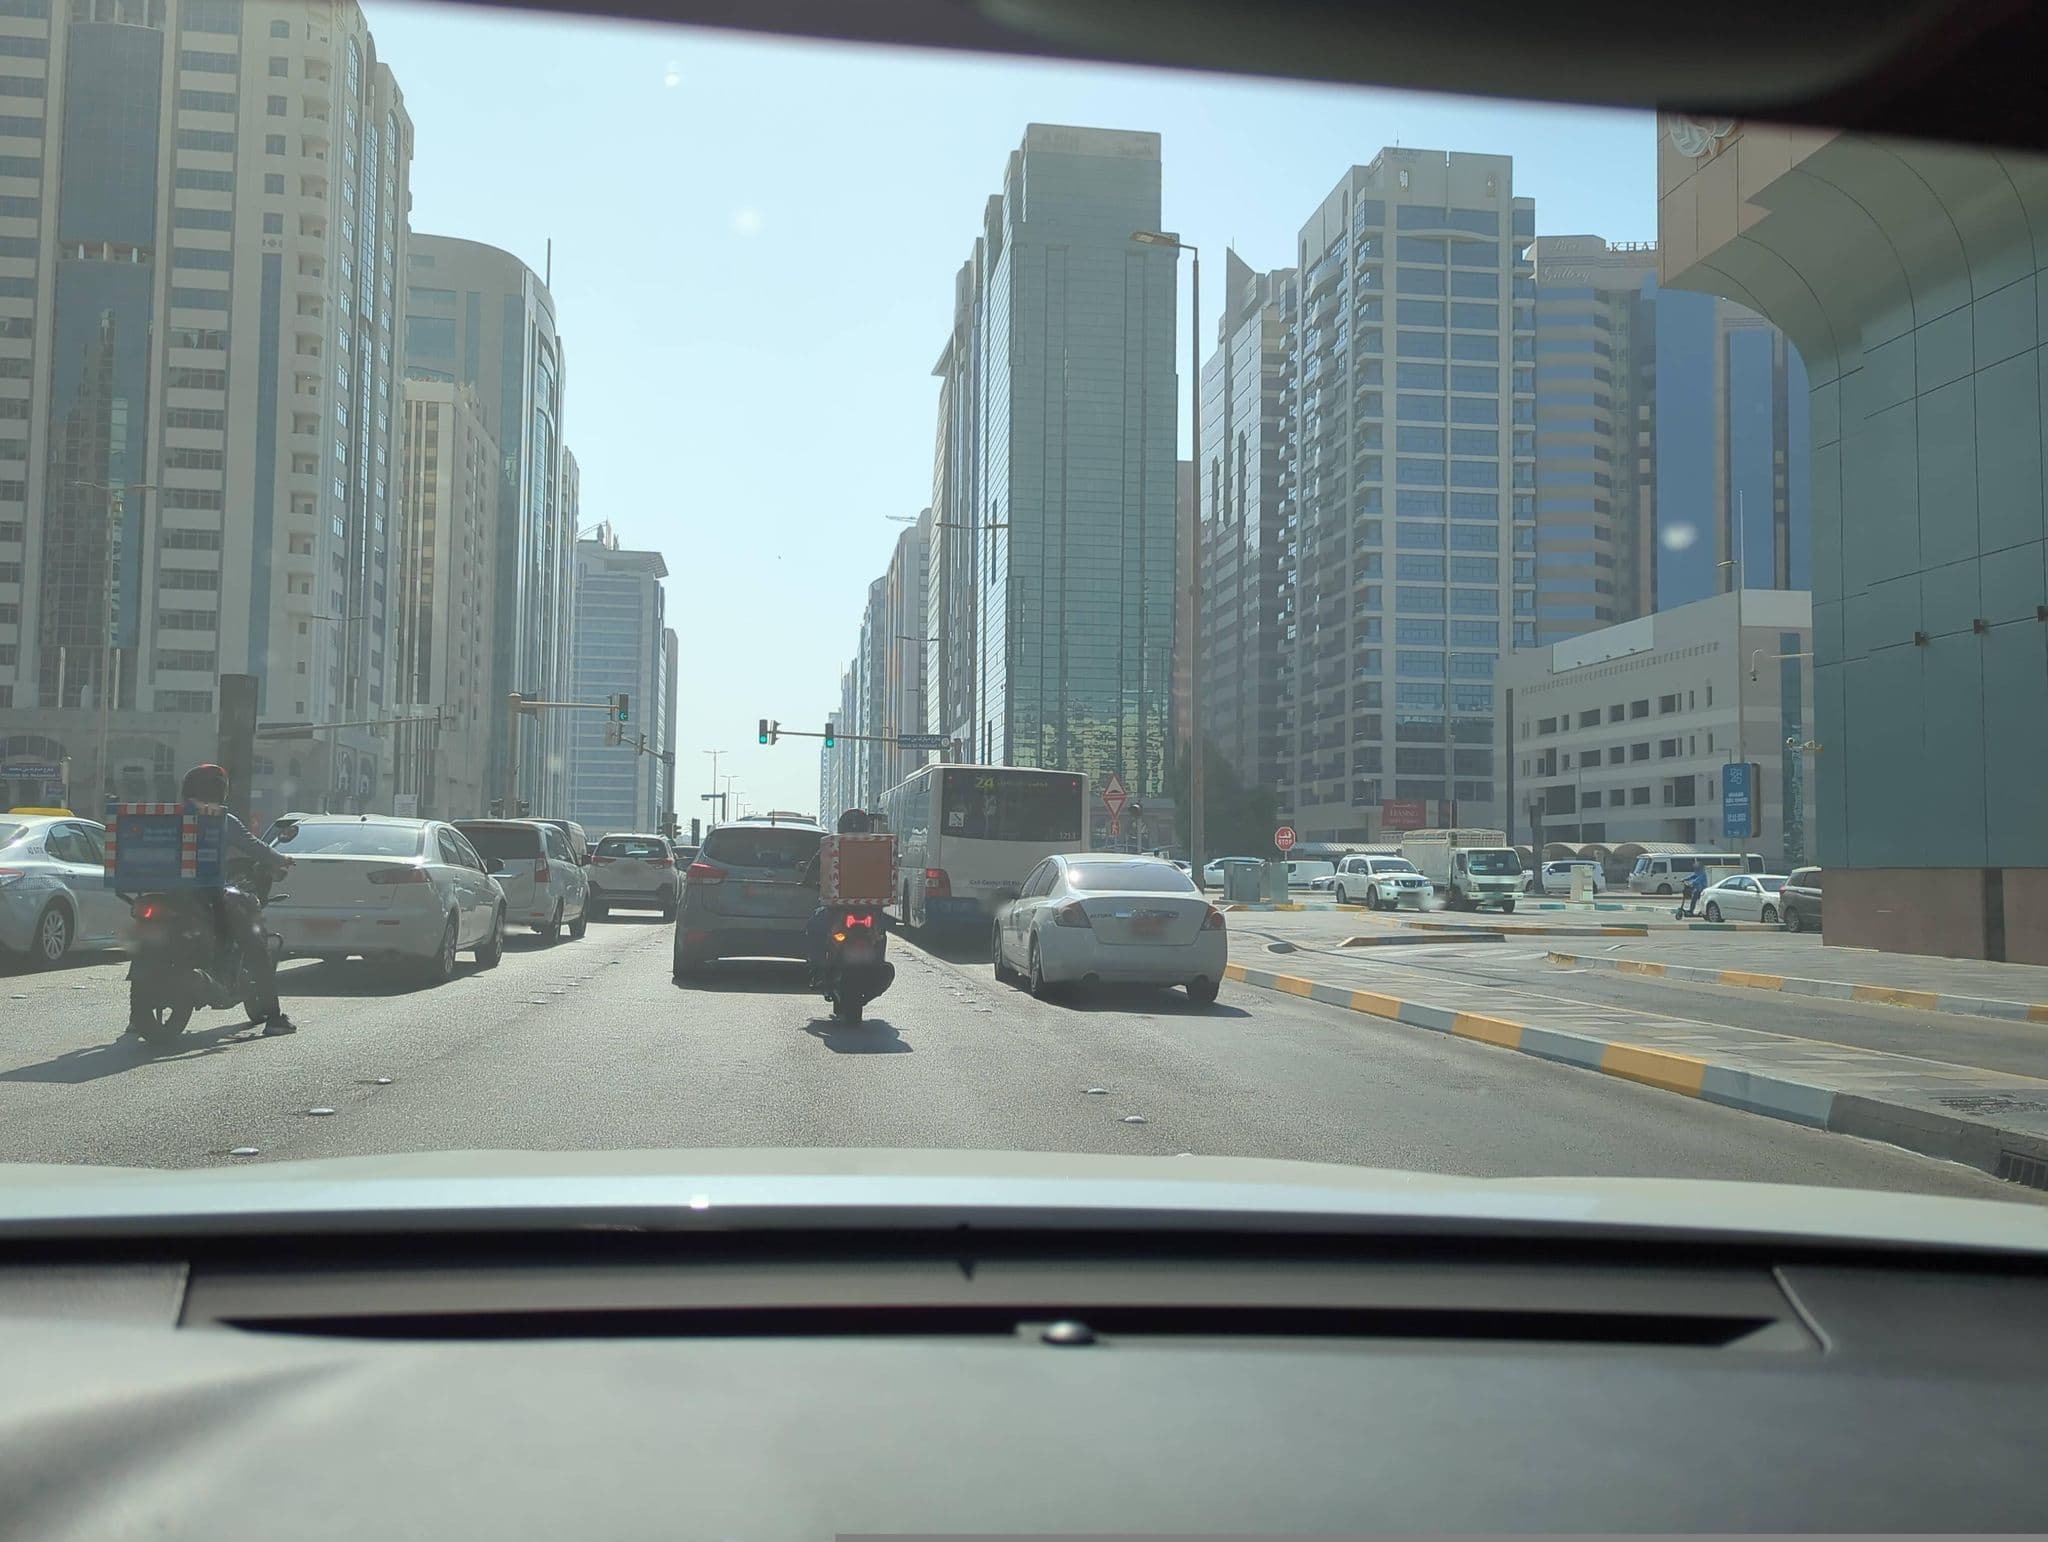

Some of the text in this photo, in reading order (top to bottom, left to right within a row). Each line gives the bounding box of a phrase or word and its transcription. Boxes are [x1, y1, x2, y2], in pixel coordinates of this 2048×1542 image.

[1544, 265, 1591, 283] Gallery
[975, 776, 995, 790] 24
[1278, 830, 1292, 839] قف
